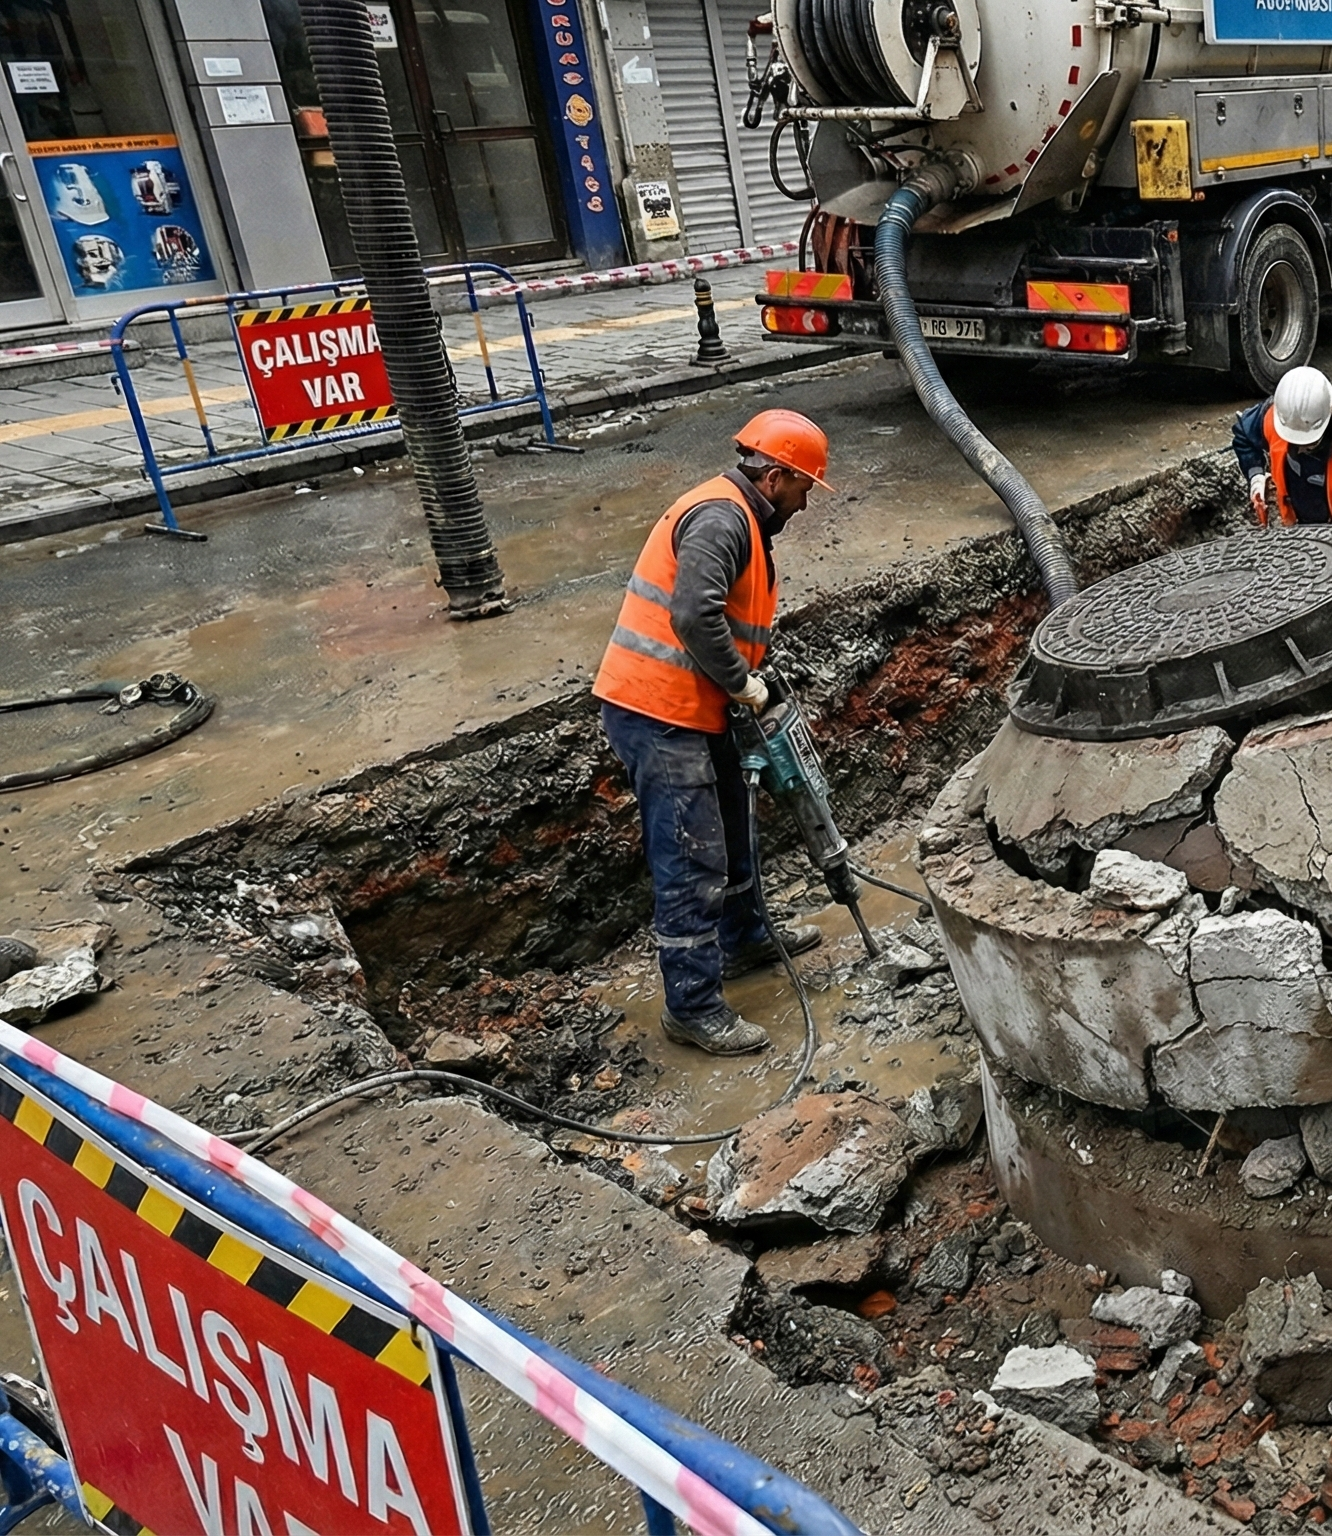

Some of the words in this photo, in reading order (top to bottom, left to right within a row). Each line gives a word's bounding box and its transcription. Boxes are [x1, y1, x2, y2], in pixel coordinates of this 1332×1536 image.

[250, 323, 382, 378] ÇALIŞMA
[301, 372, 366, 408] VAR
[17, 1178, 431, 1536] ÇALIŞMA
